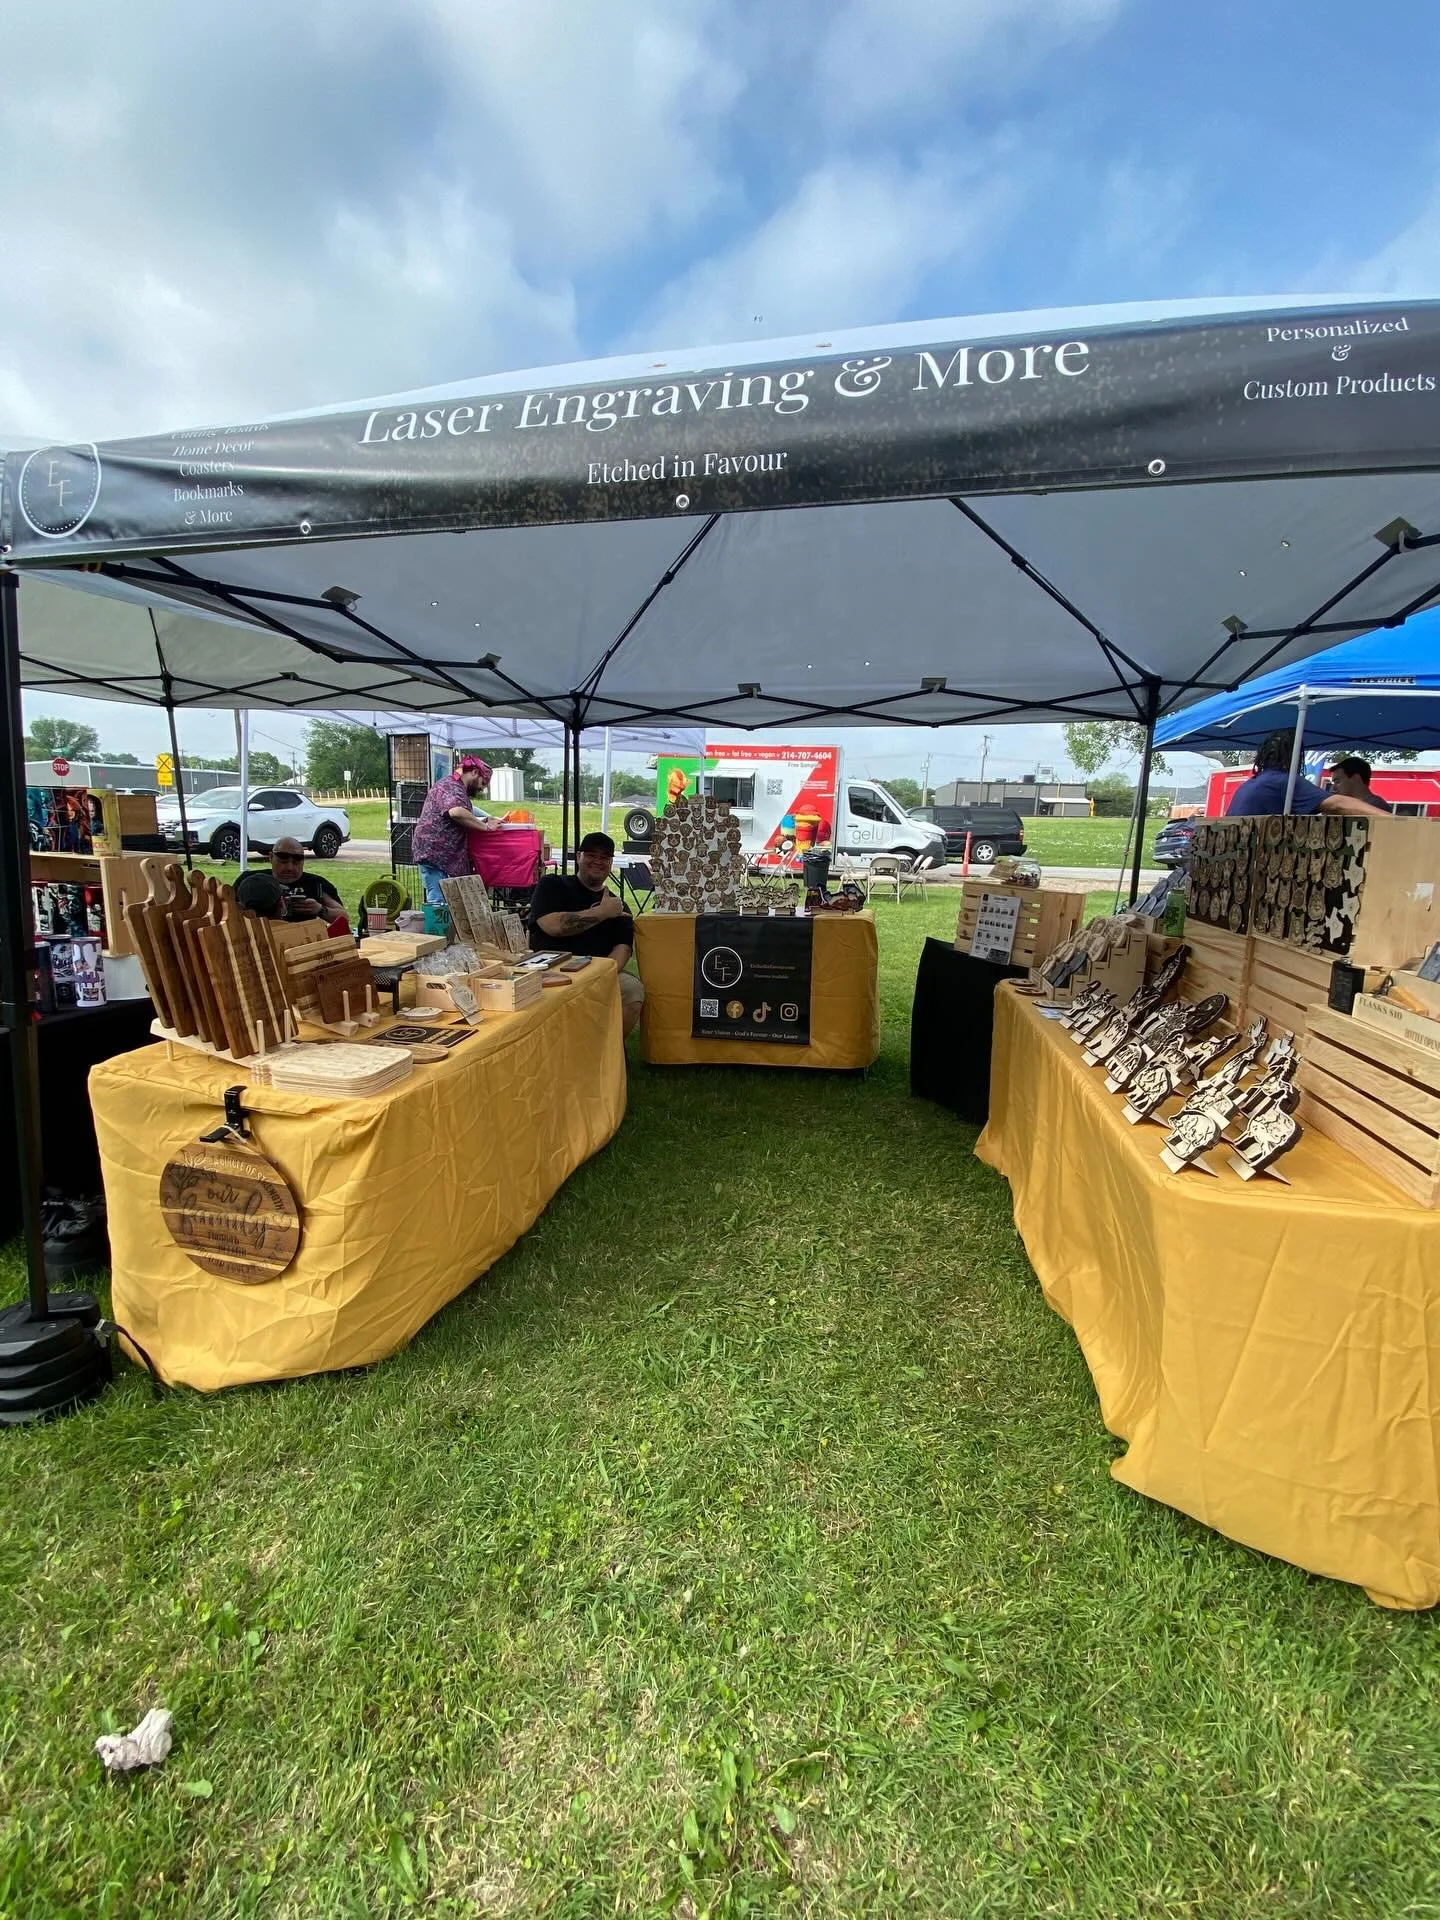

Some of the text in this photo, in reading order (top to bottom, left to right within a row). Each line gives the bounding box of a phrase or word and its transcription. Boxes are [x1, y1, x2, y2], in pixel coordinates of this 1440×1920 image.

[1266, 316, 1411, 342] Personalized
[1331, 344, 1352, 362] &
[357, 340, 1091, 444] Laser Engraving & More
[1243, 371, 1437, 401] Custom Products
[172, 440, 255, 457] Home Decor
[180, 460, 234, 477] Coasters
[586, 450, 788, 485] Etched in Favour
[174, 480, 244, 502] Bookmarks
[184, 509, 233, 525] & More
[782, 751, 832, 760] 214-707-4604
[53, 763, 70, 771] STOP
